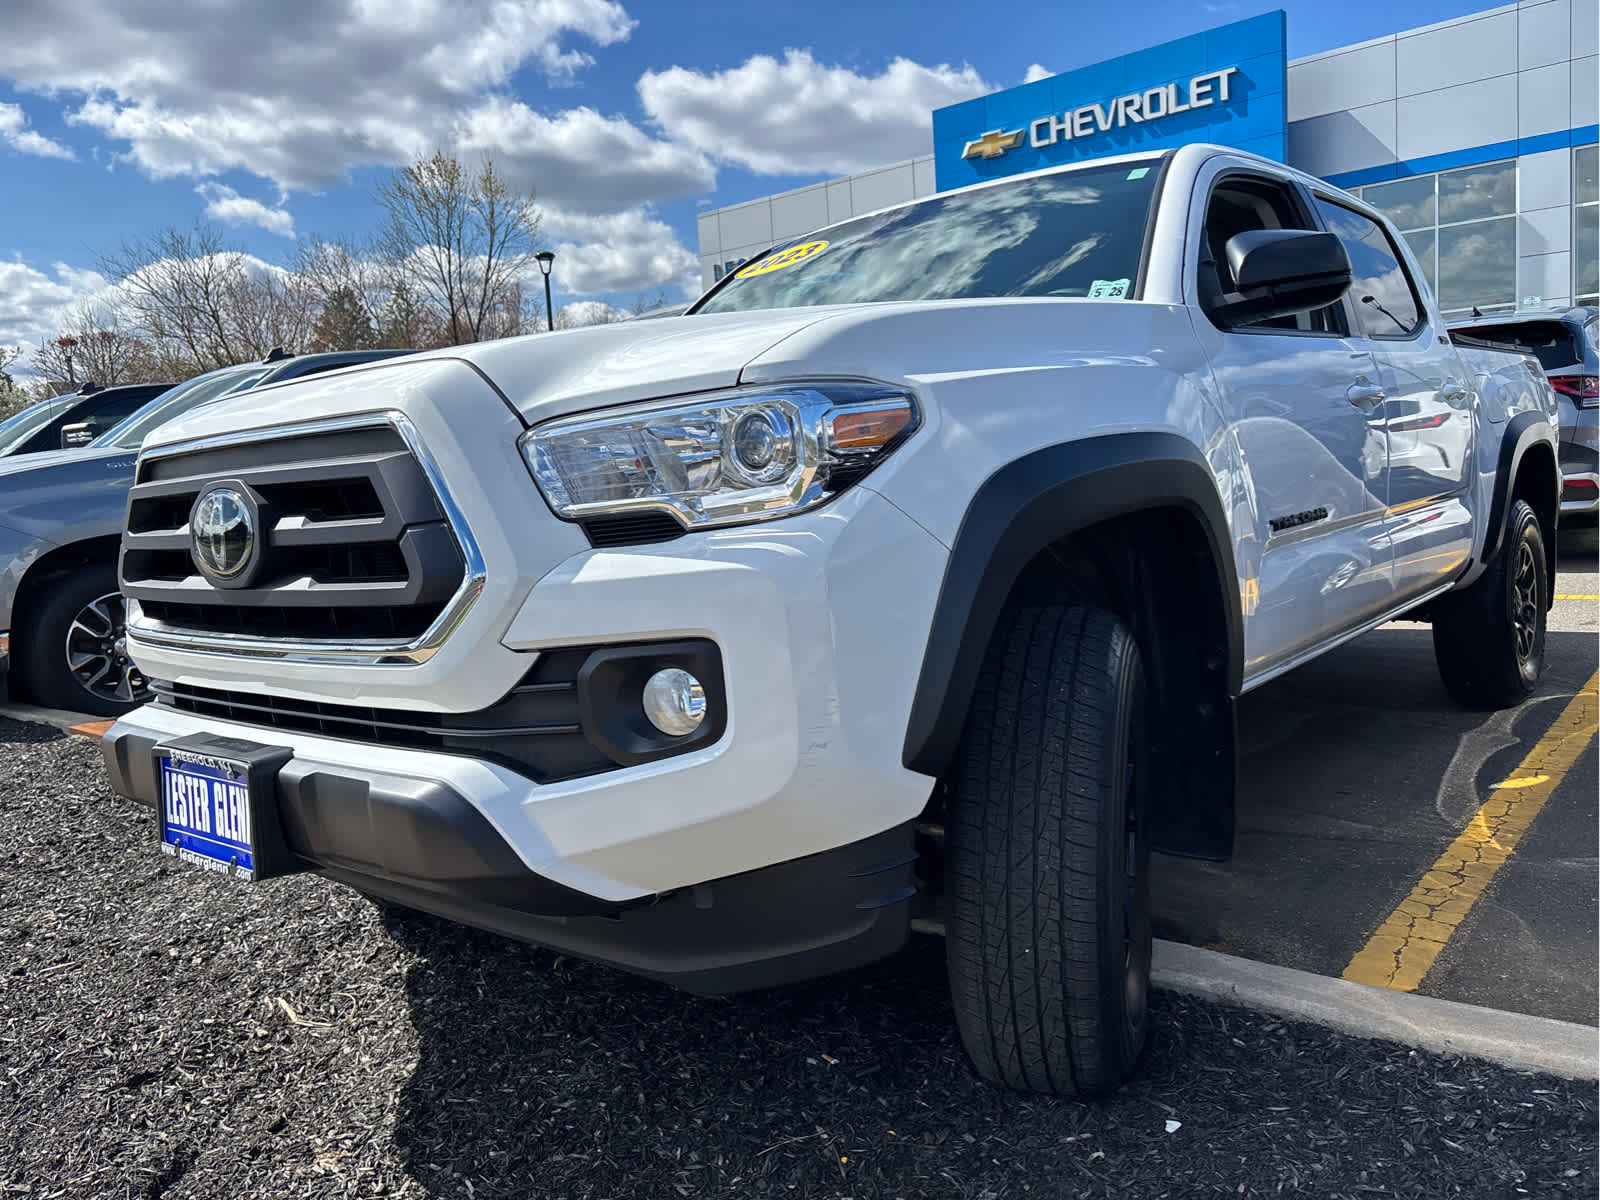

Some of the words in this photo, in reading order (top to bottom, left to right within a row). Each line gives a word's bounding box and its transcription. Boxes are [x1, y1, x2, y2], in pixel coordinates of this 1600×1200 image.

[1029, 66, 1239, 148] CHEVROLET
[1094, 287, 1103, 298] 5
[1108, 286, 1124, 297] 28
[165, 771, 210, 833] LESTER
